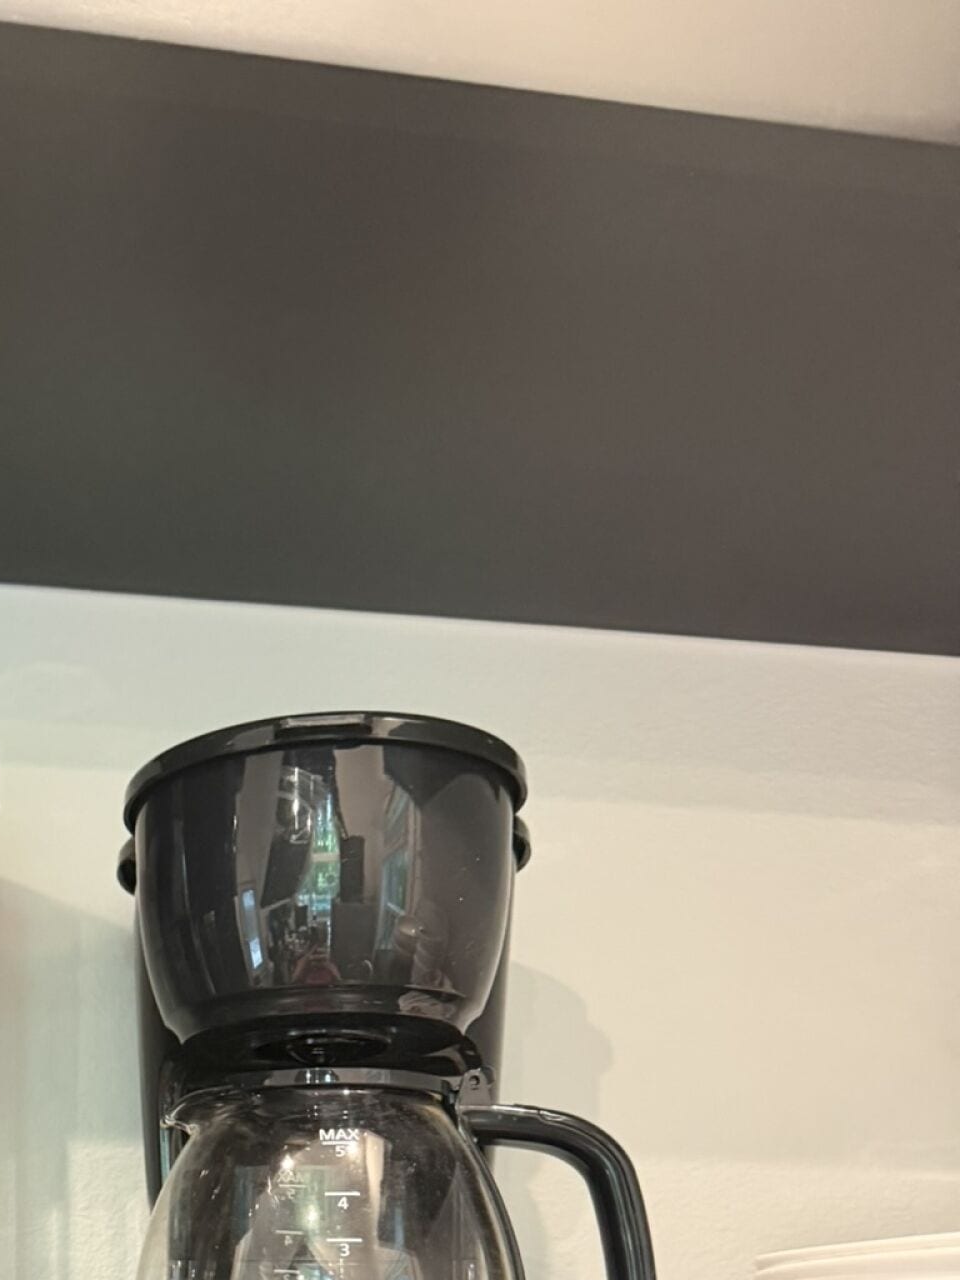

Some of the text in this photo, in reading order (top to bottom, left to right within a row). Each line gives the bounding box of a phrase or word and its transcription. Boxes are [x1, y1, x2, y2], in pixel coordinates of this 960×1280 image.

[319, 1128, 360, 1141] MAX
[335, 1145, 346, 1157] 5
[337, 1196, 350, 1210] 4
[340, 1243, 351, 1257] 3
